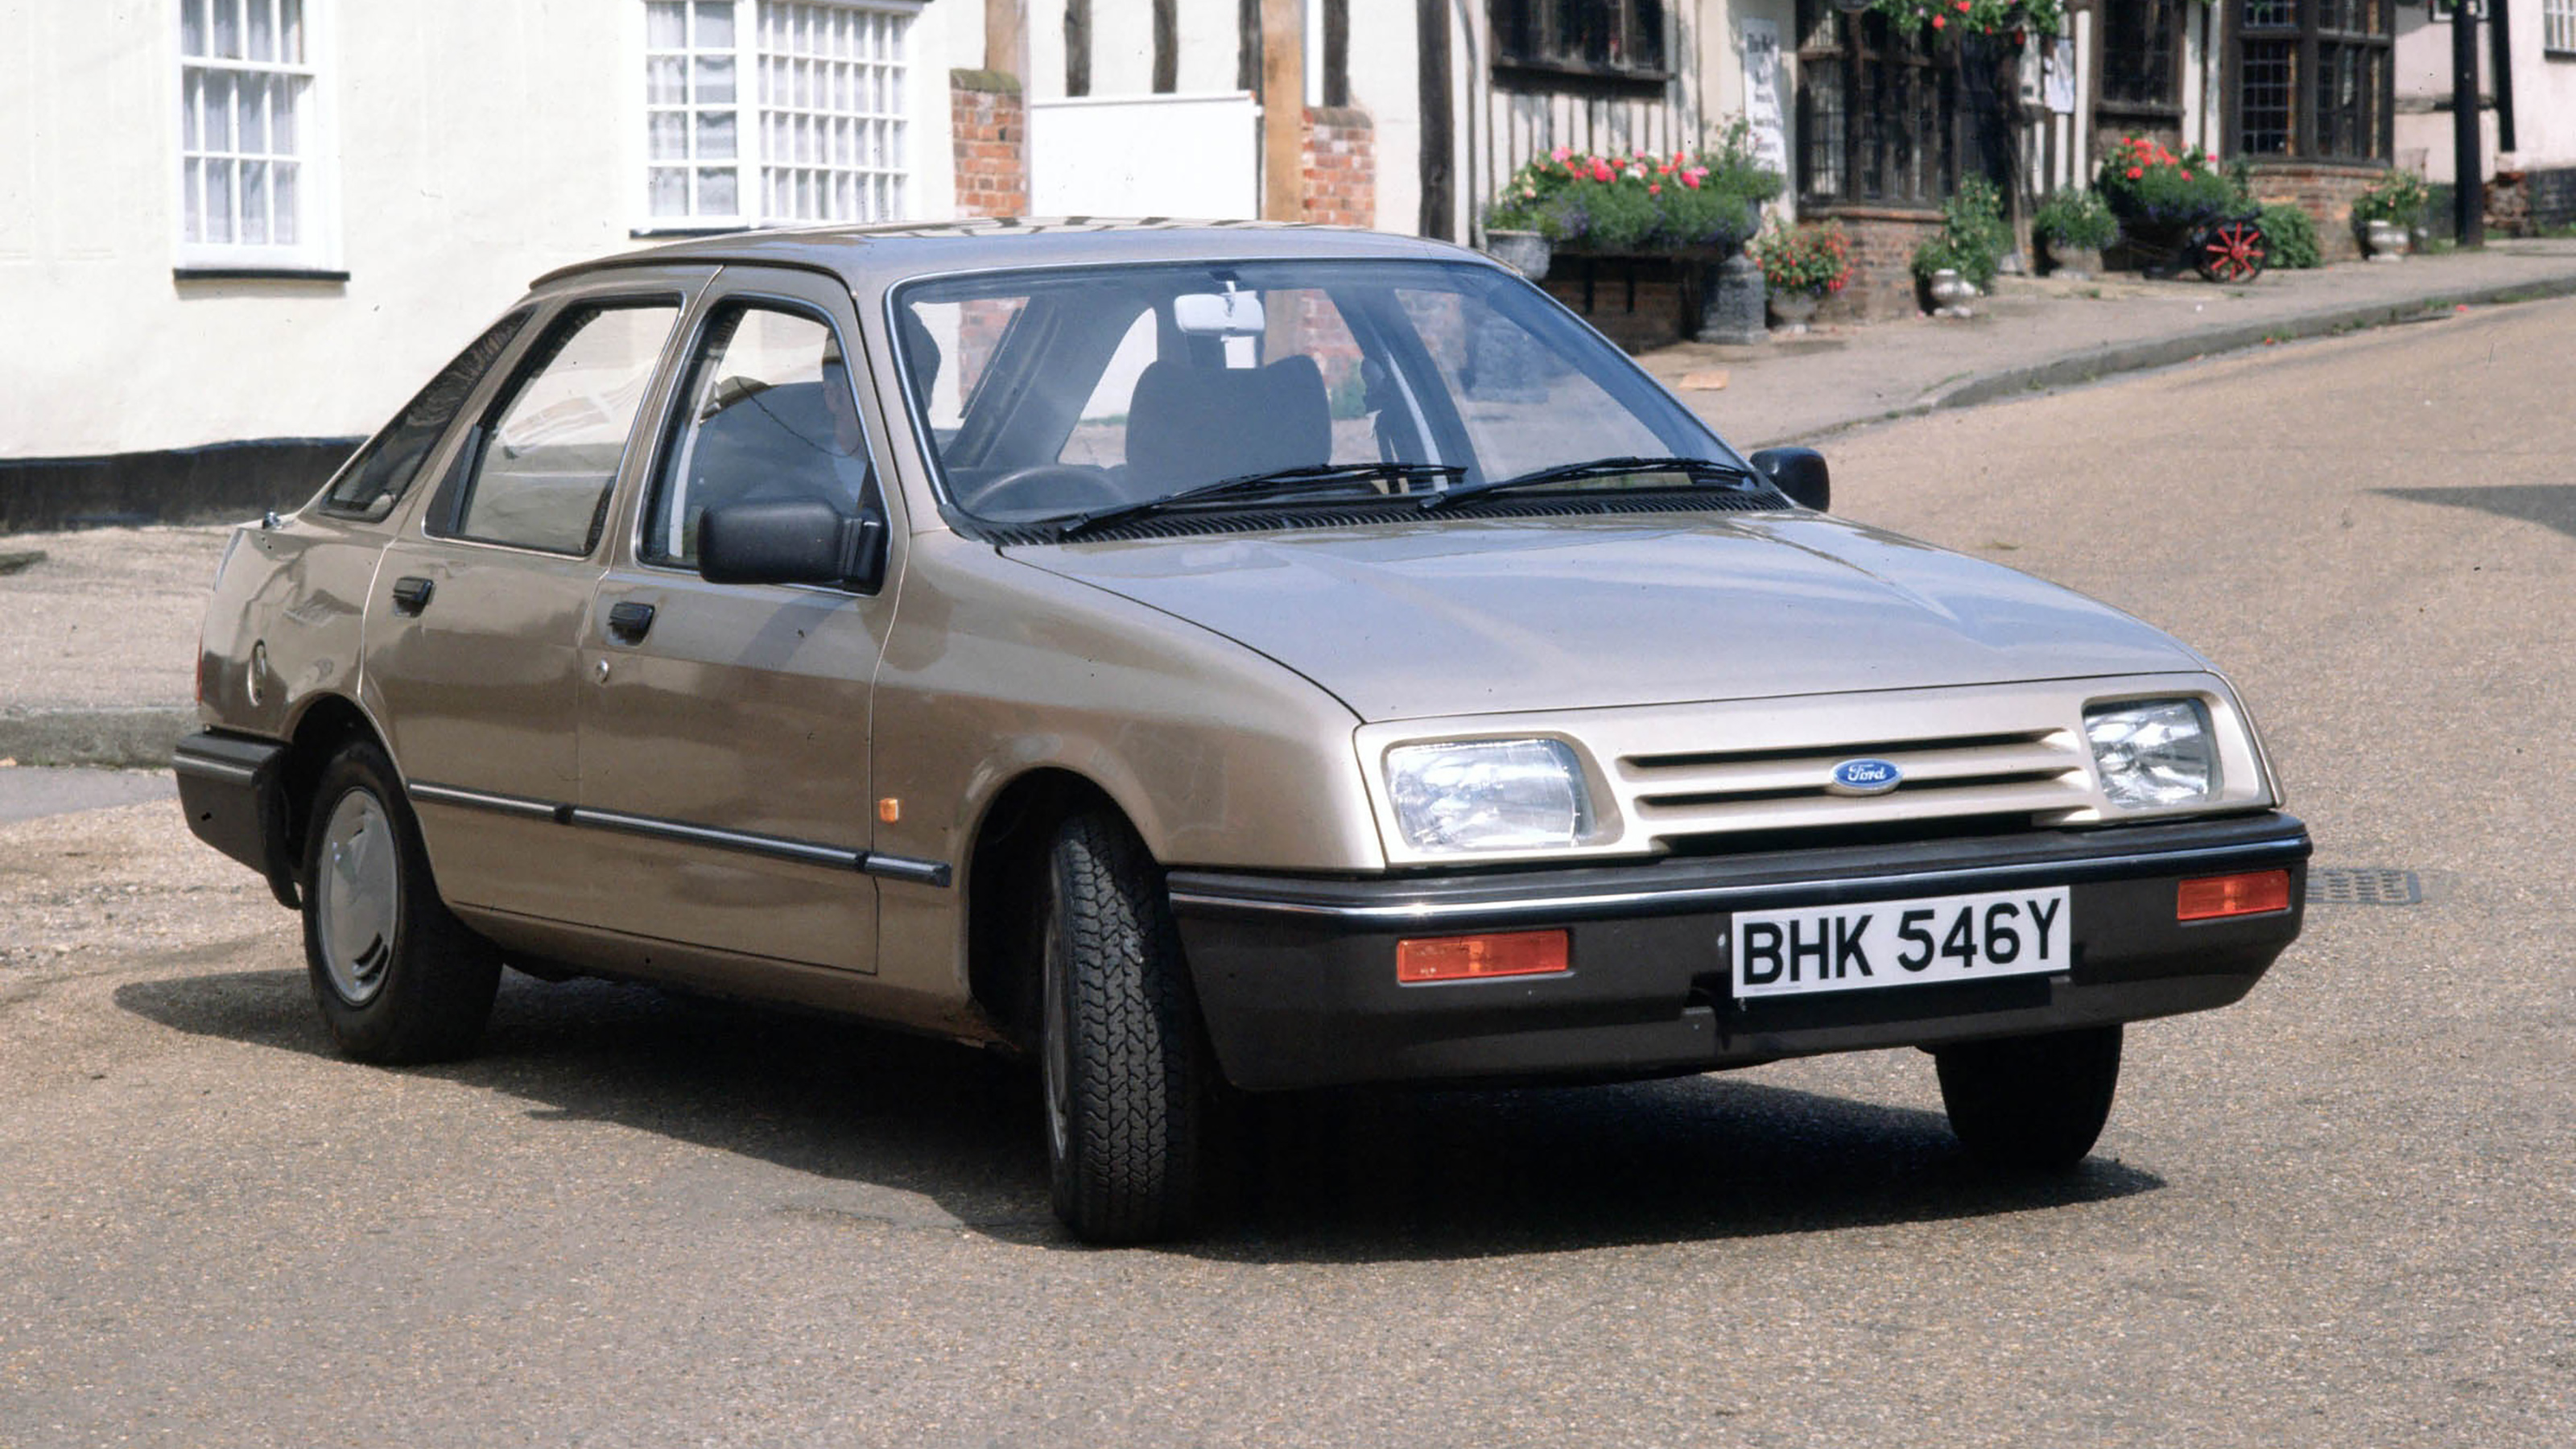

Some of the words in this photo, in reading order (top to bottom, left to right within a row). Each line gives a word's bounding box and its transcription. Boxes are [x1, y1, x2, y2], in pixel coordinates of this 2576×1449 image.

[1847, 764, 1886, 782] Ford
[1743, 914, 1874, 985] BHK
[1897, 898, 2061, 972] 546Y
